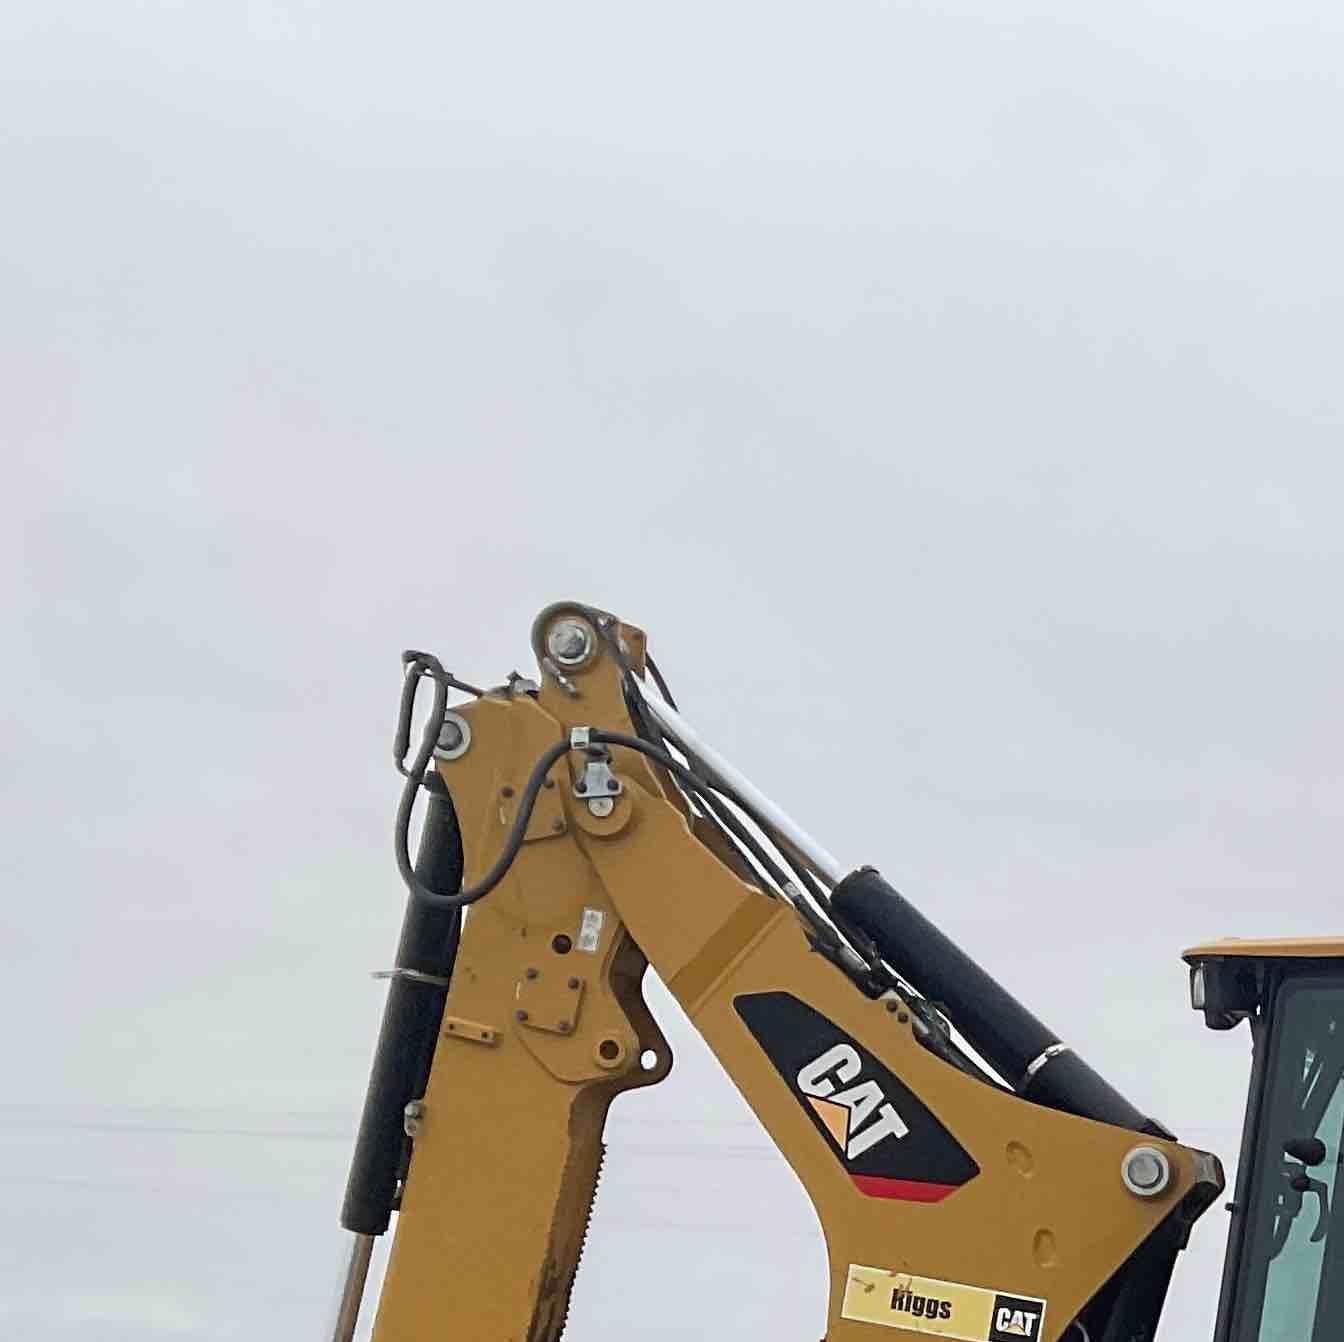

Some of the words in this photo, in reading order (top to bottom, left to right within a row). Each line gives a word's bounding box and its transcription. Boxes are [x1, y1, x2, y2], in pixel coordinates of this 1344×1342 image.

[797, 1043, 909, 1160] CAT
[890, 1288, 952, 1319] Riggs
[996, 1307, 1037, 1336] CAT
